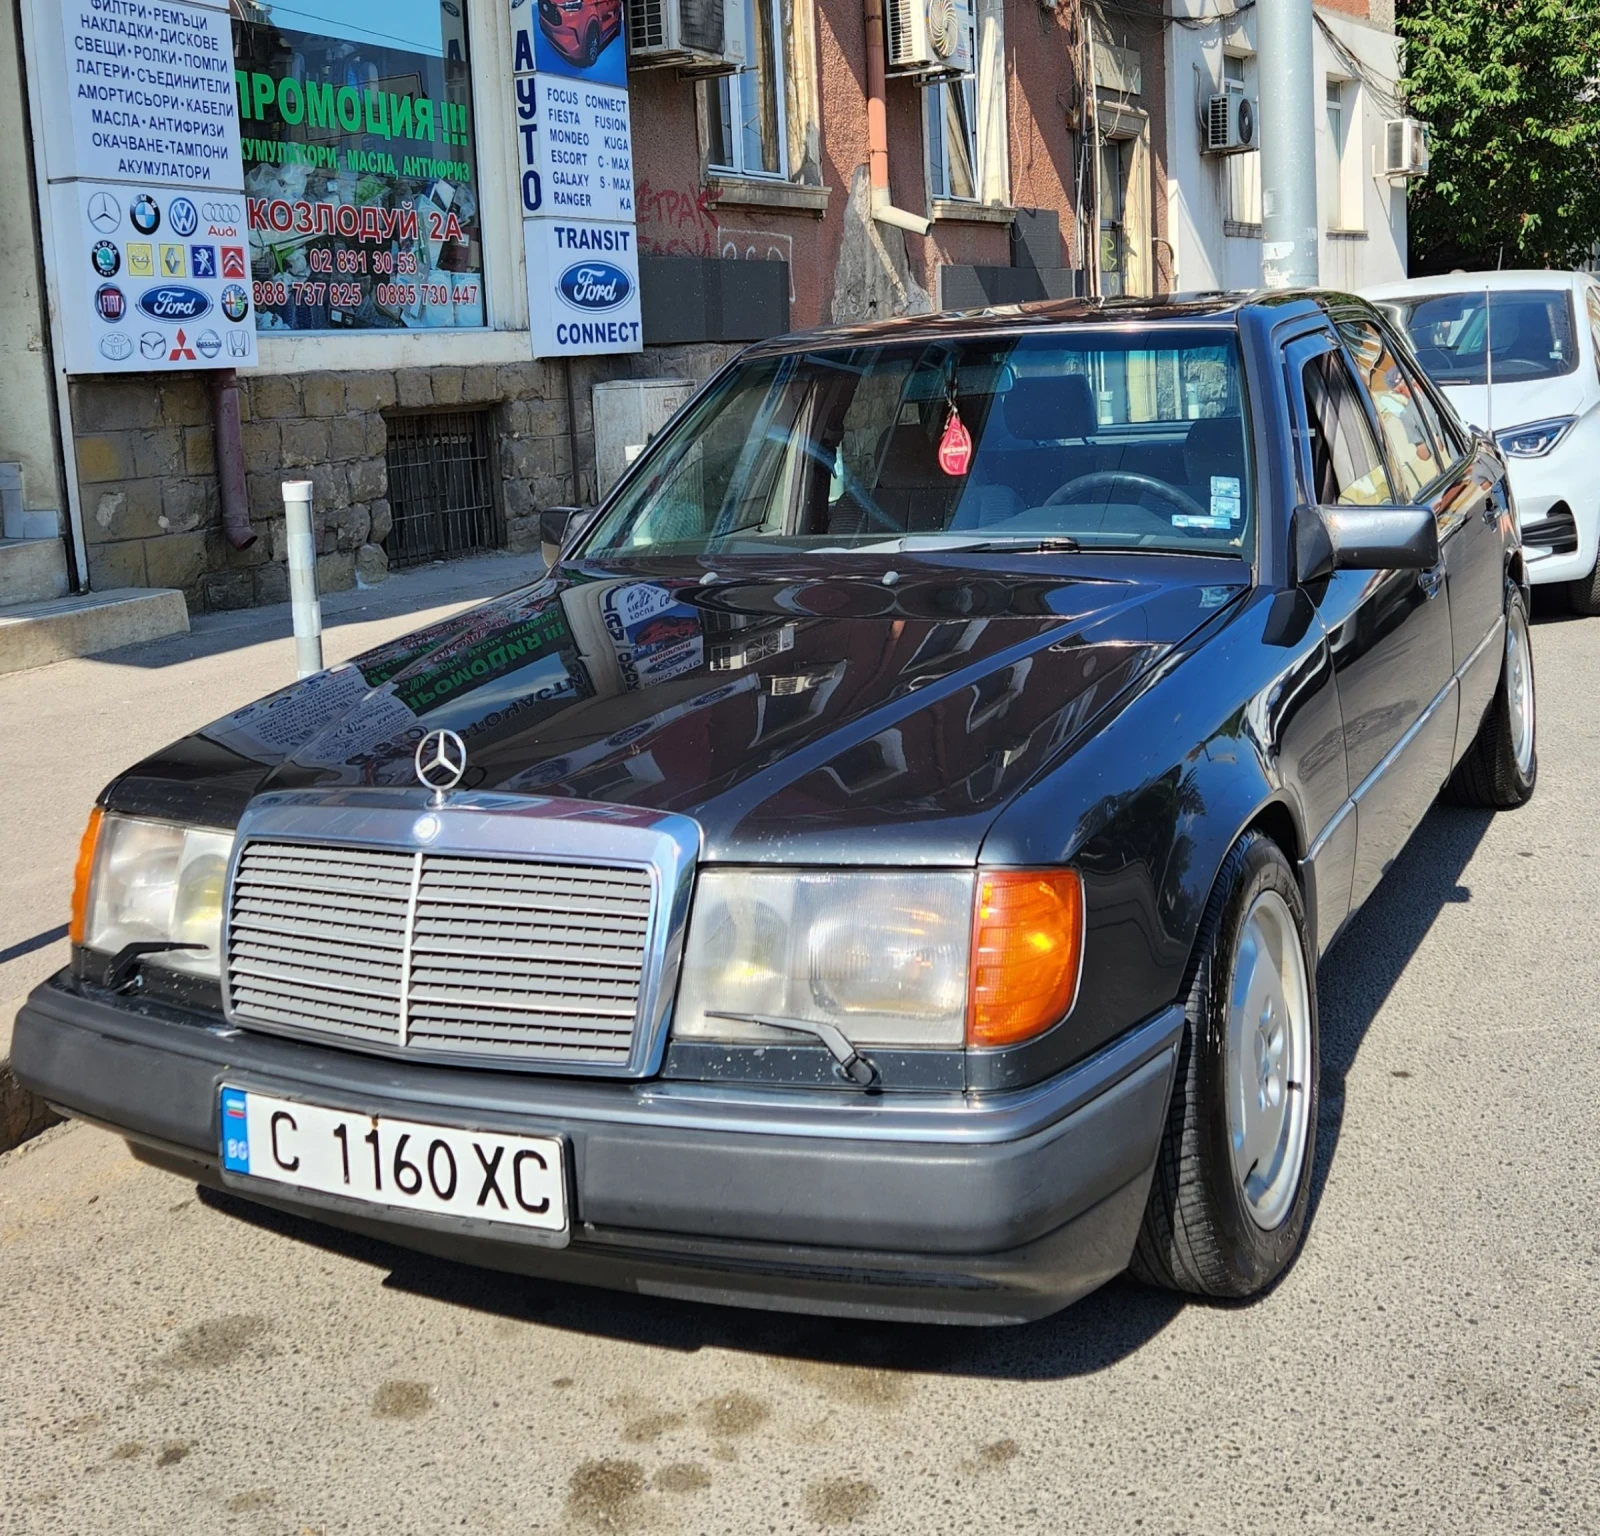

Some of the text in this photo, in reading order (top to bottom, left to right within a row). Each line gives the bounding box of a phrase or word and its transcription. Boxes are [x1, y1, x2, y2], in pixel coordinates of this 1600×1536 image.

[91, 0, 208, 31] ФИЛТРИ РЕМЪЦИ
[80, 14, 219, 51] НАКЛАДКИ ДИСКОВЕ
[74, 36, 228, 73] СВЕЩИ РОЛКИ ПОМПИ
[76, 59, 231, 95] ЛАГЕРИ СЪЕДИНИТЕЛИ
[77, 84, 234, 117] АМОРТИСЬОРИ КАБЕЛИ
[235, 70, 435, 142] ПРОМОЦИЯ
[547, 88, 626, 113] FOCUS CONNECT
[92, 109, 225, 138] МАСЛА АНТИФРИЗИ
[548, 108, 626, 132] FIESTA FUSION
[92, 133, 229, 160] ОКАЧВАНЕ ТАМПОНИ
[550, 128, 629, 151] MONDEO KUGA
[118, 159, 211, 180] АКУМУЛАТОРИ
[240, 137, 470, 182] КУМУЛАТОРИ, МАСЛА, АНТИФРИЗ
[551, 150, 587, 166] ESCORT
[553, 171, 589, 187] GALAXY
[554, 192, 632, 210] RANGER KA
[208, 225, 237, 237] Audi
[247, 197, 464, 244] КОЗЛОДУЙ 2А
[554, 226, 630, 251] TRANSIT
[309, 248, 417, 274] 02 831 30 53
[252, 281, 362, 306] 888 737 825
[377, 284, 478, 306] 0885 730 447
[573, 268, 617, 301] Ford
[102, 295, 121, 312] FIAT
[154, 290, 196, 315] Ford
[557, 322, 639, 345] CONNECT
[227, 1111, 550, 1214] BG C 1160 XC
